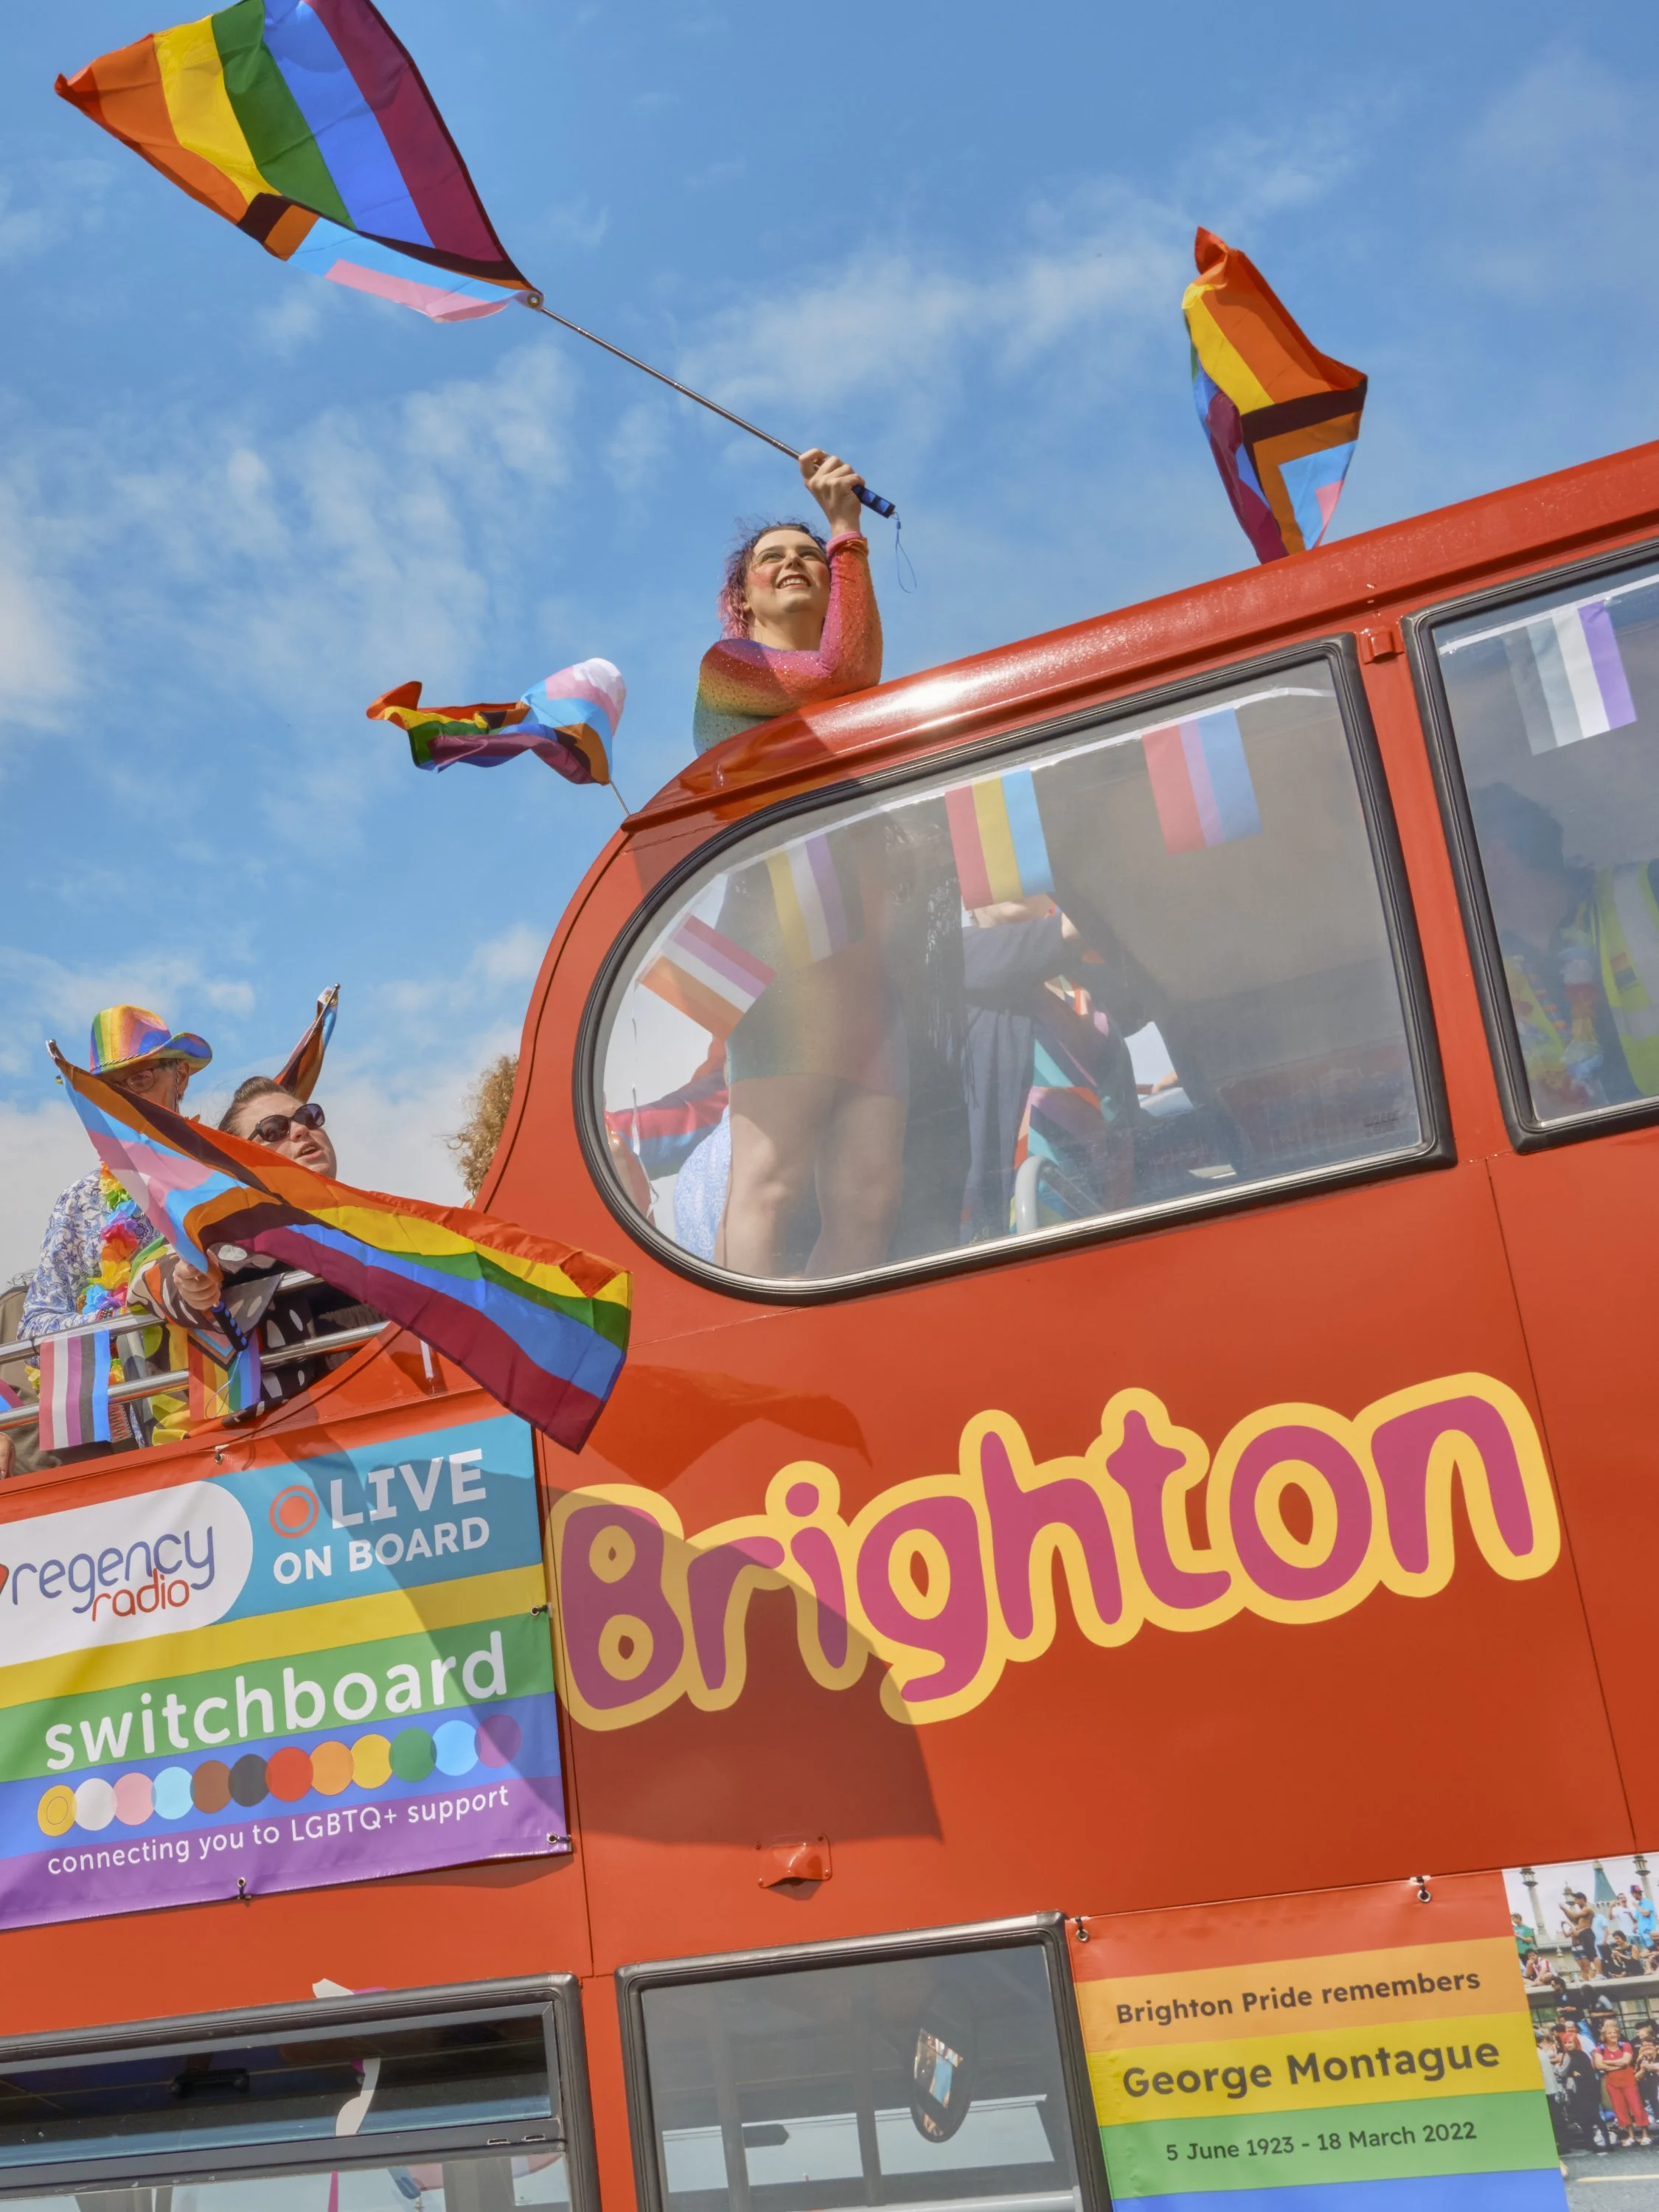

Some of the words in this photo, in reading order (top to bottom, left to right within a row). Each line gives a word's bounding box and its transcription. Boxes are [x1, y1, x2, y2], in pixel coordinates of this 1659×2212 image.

[330, 1448, 487, 1529] LIVE
[12, 1526, 215, 1613] regency
[274, 1546, 332, 1585] ON
[349, 1517, 490, 1572] BOARD
[546, 1371, 1561, 1731] Brighton
[92, 1568, 189, 1621] radio
[45, 1630, 507, 1770] switchboard
[48, 1837, 189, 1875] connecting
[199, 1833, 244, 1858] you
[253, 1823, 279, 1845] to
[291, 1808, 397, 1842] LGBTQ+
[408, 1785, 509, 1826] support
[1116, 1998, 1233, 2025] Brighton
[1242, 1985, 1312, 2013] Pride
[1322, 1969, 1481, 2003] remembers
[1123, 2065, 1272, 2099] George
[1286, 2042, 1500, 2085] Montague
[1166, 2143, 1178, 2160] 5
[1186, 2140, 1239, 2161] June
[1247, 2137, 1294, 2156] 1923
[1318, 2133, 1342, 2152] 18
[1349, 2126, 1416, 2149] March
[1423, 2121, 1477, 2142] 2022
